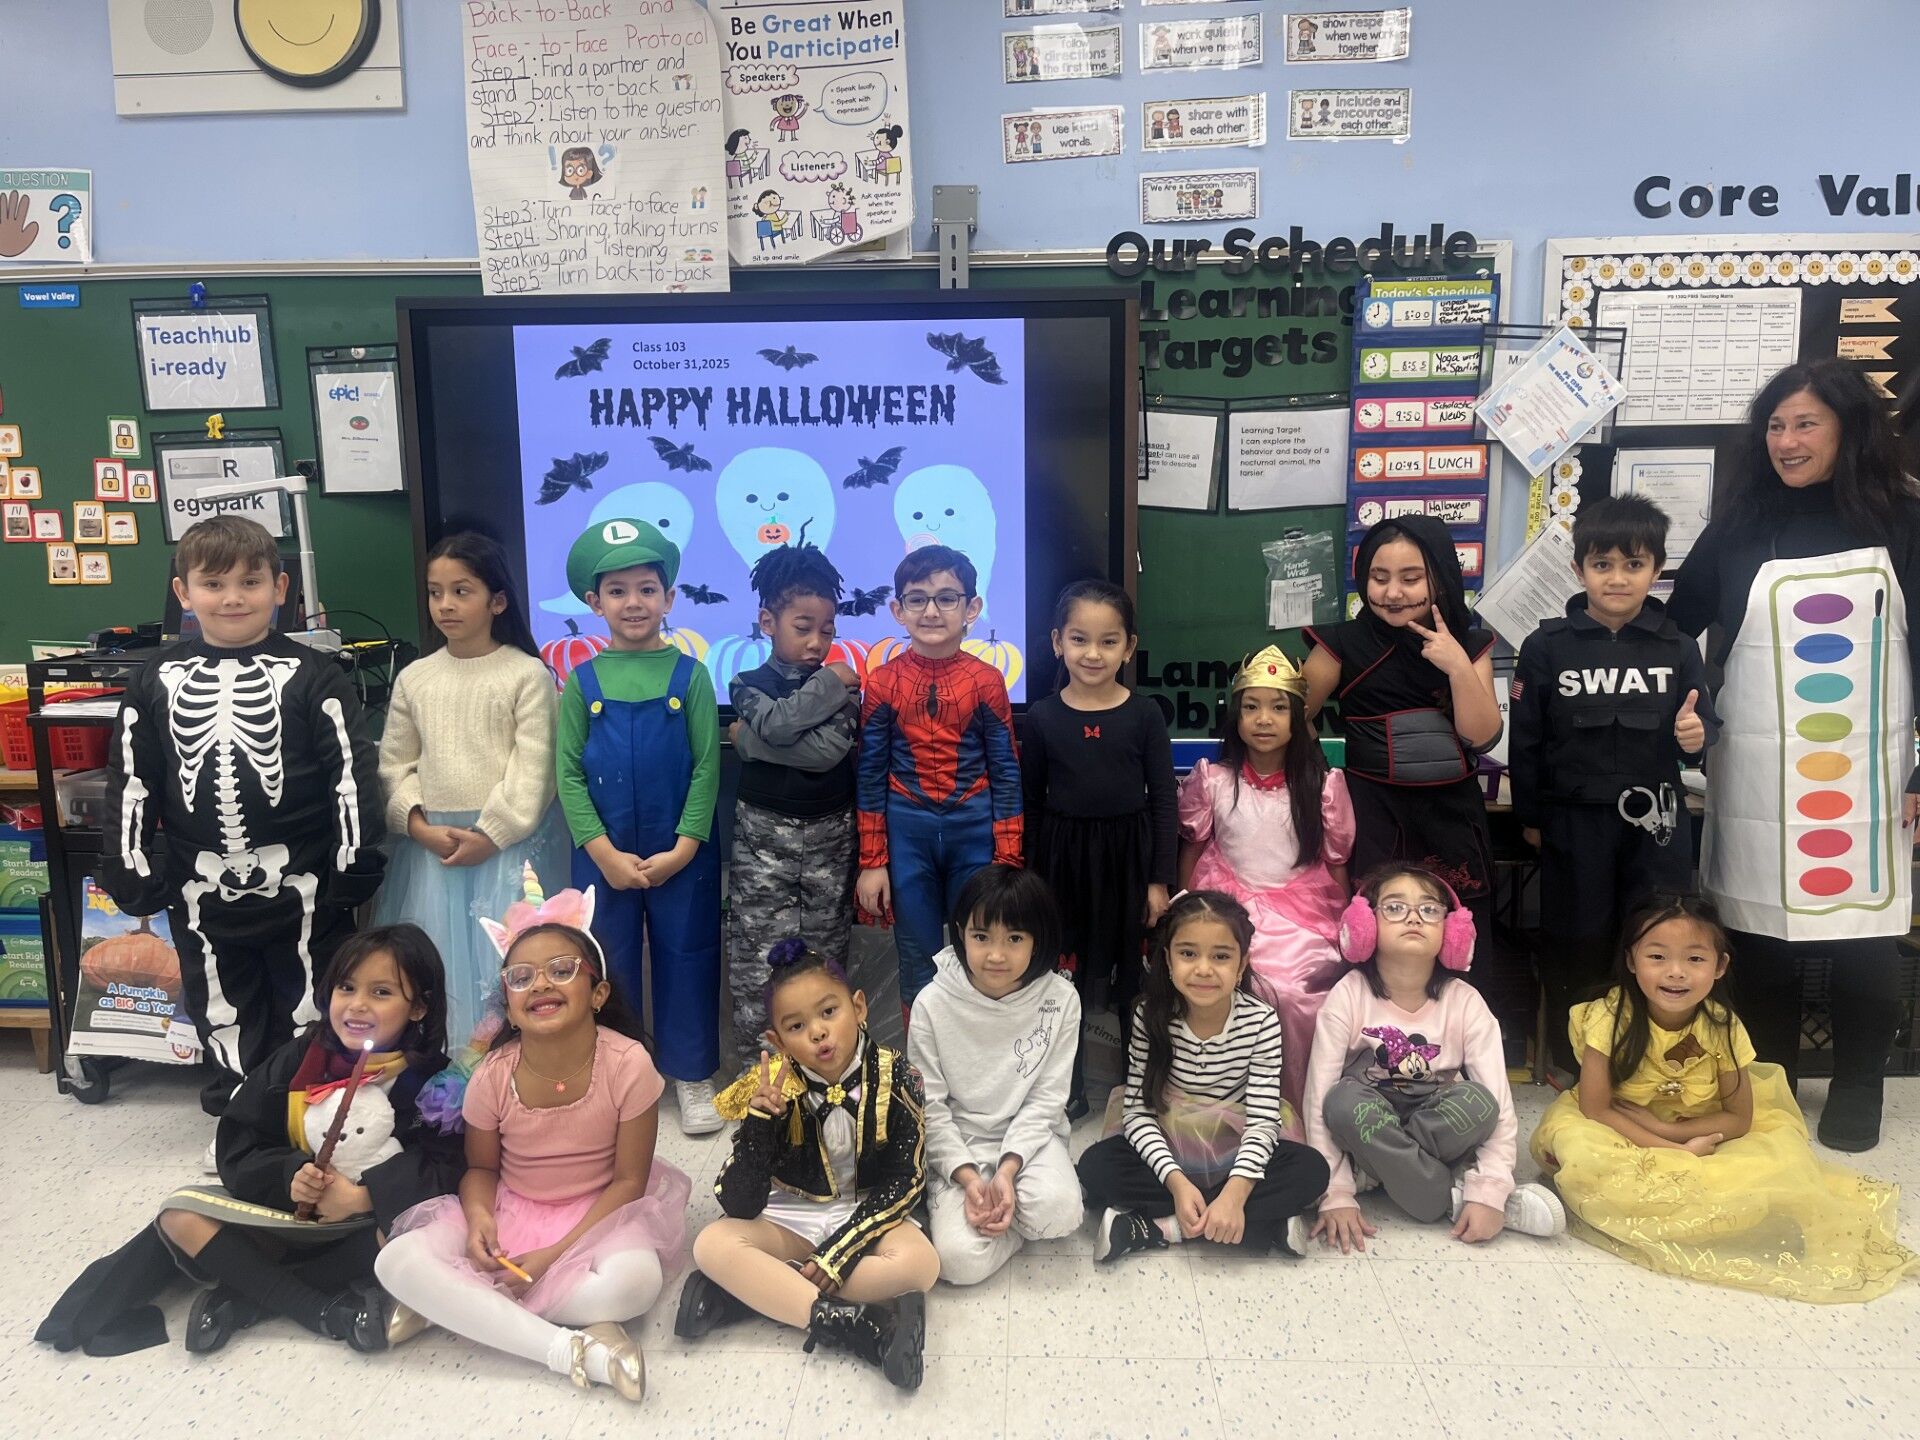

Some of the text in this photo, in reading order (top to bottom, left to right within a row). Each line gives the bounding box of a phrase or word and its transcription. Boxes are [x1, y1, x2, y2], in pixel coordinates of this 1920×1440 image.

[469, 0, 612, 27] Back-to-Back
[731, 10, 892, 35] Be Great When
[1323, 18, 1347, 29] show
[473, 18, 708, 60] Face-to-Face Protocol
[1177, 26, 1246, 40] work quietly
[1325, 29, 1393, 41] when we work
[726, 29, 899, 61] You Participate!
[1172, 43, 1196, 54] when
[1199, 43, 1214, 53] we
[1217, 42, 1240, 53] need
[1045, 48, 1106, 61] directions
[579, 63, 588, 75] a
[593, 56, 650, 81] partner
[657, 47, 685, 71] and
[1043, 62, 1060, 73] the
[740, 73, 785, 83] Speakers
[472, 80, 517, 105] stand
[1336, 96, 1400, 106] include and
[549, 102, 597, 121] Listen
[605, 102, 620, 119] to
[624, 99, 648, 117] the
[656, 92, 721, 127] question
[1188, 108, 1248, 121] share with
[1334, 108, 1401, 119] encourage
[1053, 120, 1098, 134] use kind
[1190, 125, 1212, 136] each
[1341, 120, 1363, 129] each
[471, 125, 496, 148] and
[504, 125, 542, 144] think
[550, 123, 593, 144] about
[600, 128, 631, 144] your
[1060, 137, 1092, 147] words.
[791, 162, 835, 171] Listeners
[1634, 174, 1920, 218] Core Val
[590, 192, 679, 216] face-to-face
[614, 216, 666, 242] taking
[670, 215, 719, 236] turns
[1107, 222, 1477, 277] Our Schedule
[487, 251, 550, 275] speaking
[559, 239, 587, 261] and
[552, 262, 588, 287] Turn
[597, 257, 712, 283] back-to-back
[24, 293, 75, 301] Vowel Valley
[1375, 286, 1485, 298] Today's Schedule
[146, 325, 251, 345] Teachhub
[632, 342, 686, 352] Class 103
[1139, 327, 1338, 378] Targets
[633, 359, 730, 371] October 31,2025
[1436, 352, 1460, 366] Yoga
[151, 358, 227, 379] i-ready
[329, 385, 359, 401] epic!
[589, 384, 957, 430] HAPPY HALLOWEEN
[1431, 401, 1473, 409] Scholastic
[1396, 410, 1421, 422] 9:50
[1389, 461, 1420, 470] 10:45
[1428, 457, 1473, 470] LUNCH
[1428, 501, 1471, 512] Halloween
[611, 525, 631, 540] L
[1287, 568, 1309, 578] Wrap
[1558, 667, 1673, 696] SWAT
[3, 860, 23, 868] Start
[9, 868, 43, 877] Readers
[26, 951, 45, 961] Righ
[9, 961, 44, 969] Readers
[107, 982, 167, 1000] A Pumpkin
[99, 999, 114, 1008] as
[115, 998, 134, 1009] BIG
[136, 1001, 150, 1010] as
